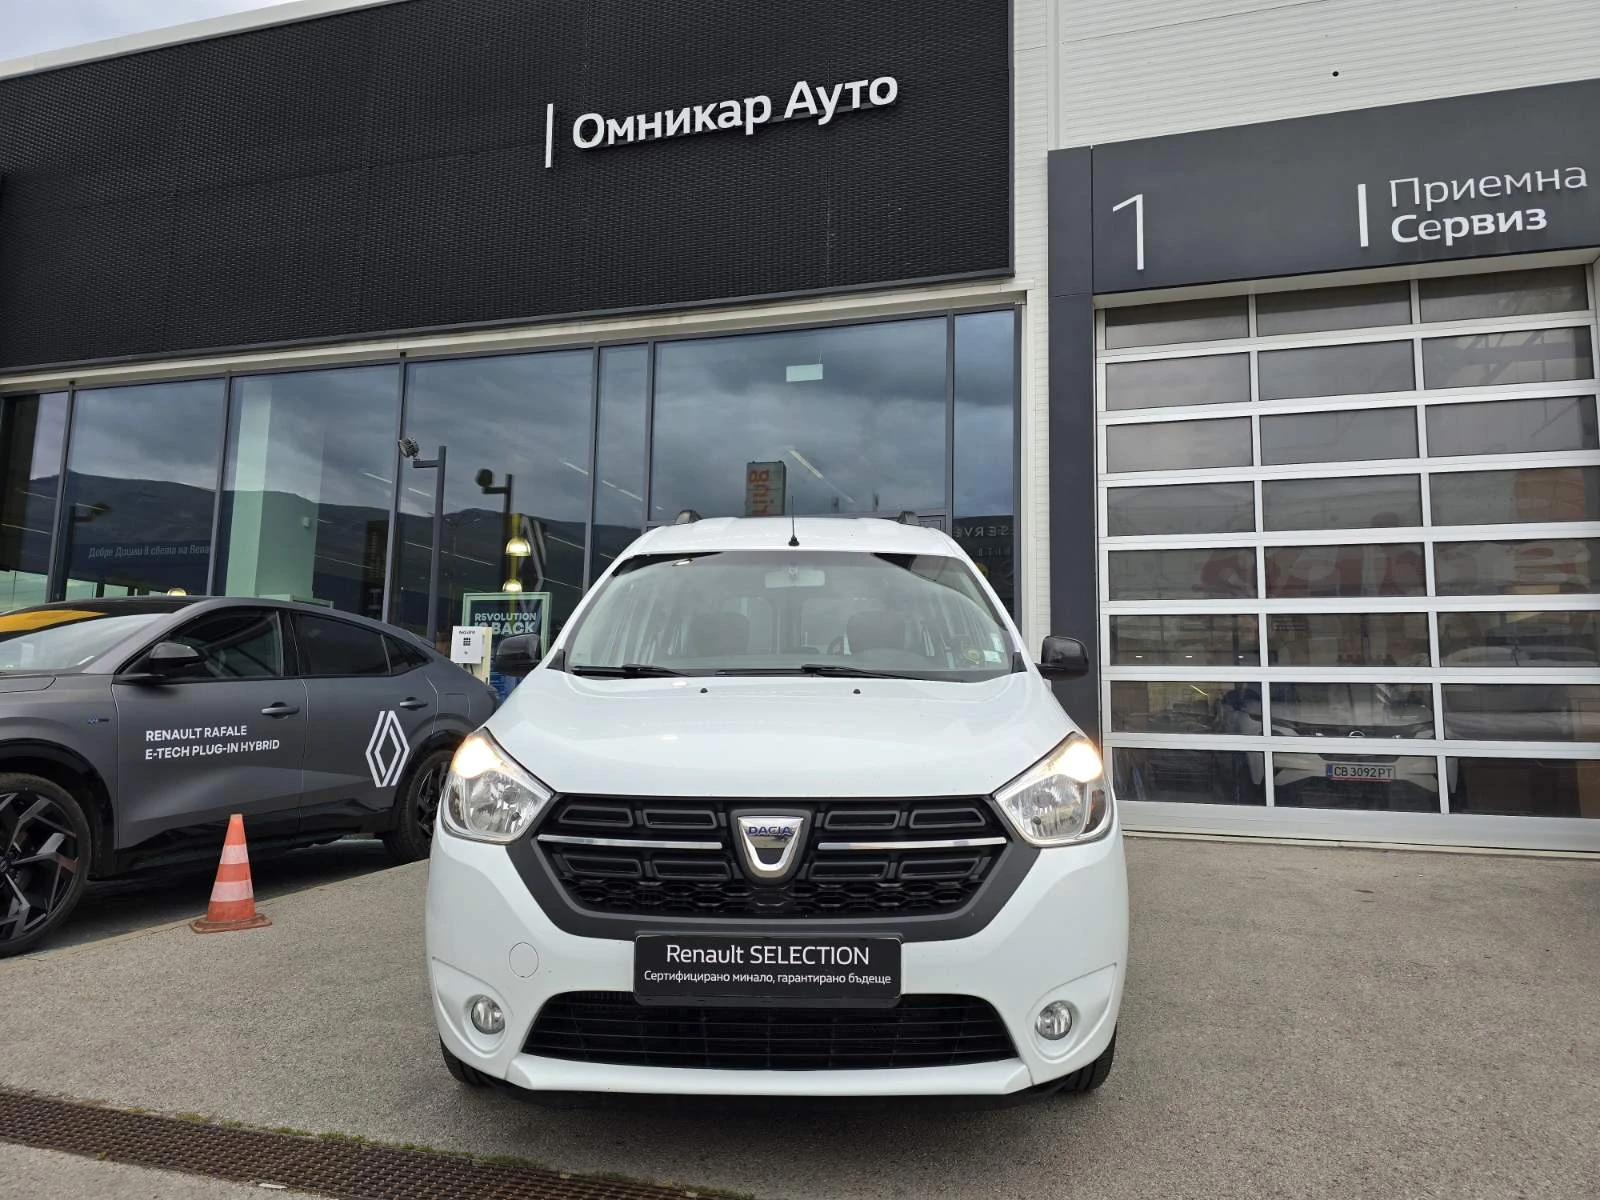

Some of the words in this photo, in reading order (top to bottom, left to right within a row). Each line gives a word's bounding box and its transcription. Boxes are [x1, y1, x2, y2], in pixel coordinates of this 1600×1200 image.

[572, 94, 772, 149] Омникар
[783, 76, 898, 125] Ауто
[1389, 167, 1588, 211] Приемна
[1112, 193, 1144, 270] 1
[1391, 208, 1547, 246] Сервиз
[491, 621, 535, 635] BACK
[145, 728, 202, 742] RENAULT
[204, 725, 247, 738] RAFALE
[145, 746, 190, 760] E-TECH
[191, 742, 239, 756] PLUG-IN
[240, 739, 280, 752] HYBRID
[748, 826, 793, 836] DACIA
[666, 944, 744, 964] Renault
[749, 946, 869, 965] SELECTION
[644, 970, 730, 983] Сертифицирано
[732, 973, 776, 984] минало,
[777, 974, 846, 985] гарантирано
[848, 972, 892, 985] бъдеще
